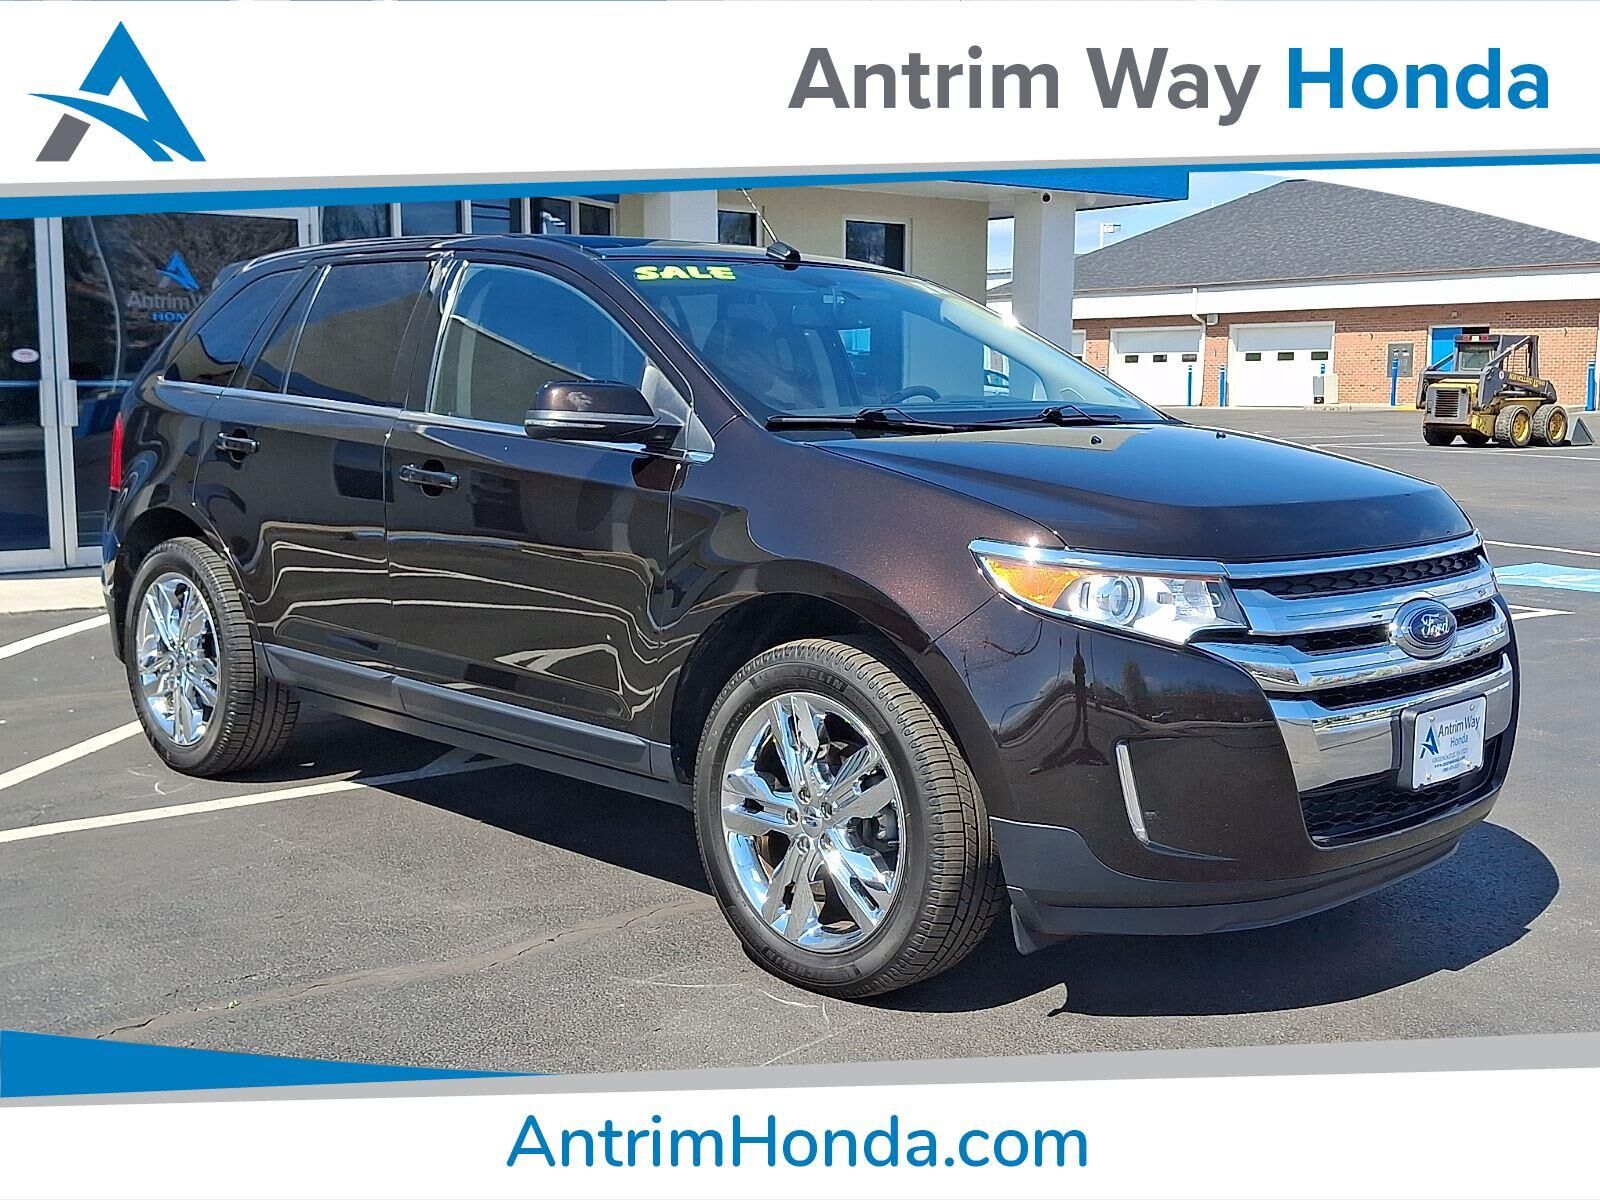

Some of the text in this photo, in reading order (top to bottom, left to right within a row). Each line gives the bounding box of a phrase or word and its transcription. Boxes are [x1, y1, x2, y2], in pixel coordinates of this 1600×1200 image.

[634, 265, 736, 281] SALE
[127, 291, 190, 310] Antrim
[152, 312, 188, 321] HON
[1420, 612, 1450, 639] Ford
[1437, 715, 1481, 738] Antrim Way
[1450, 732, 1469, 748] Honda
